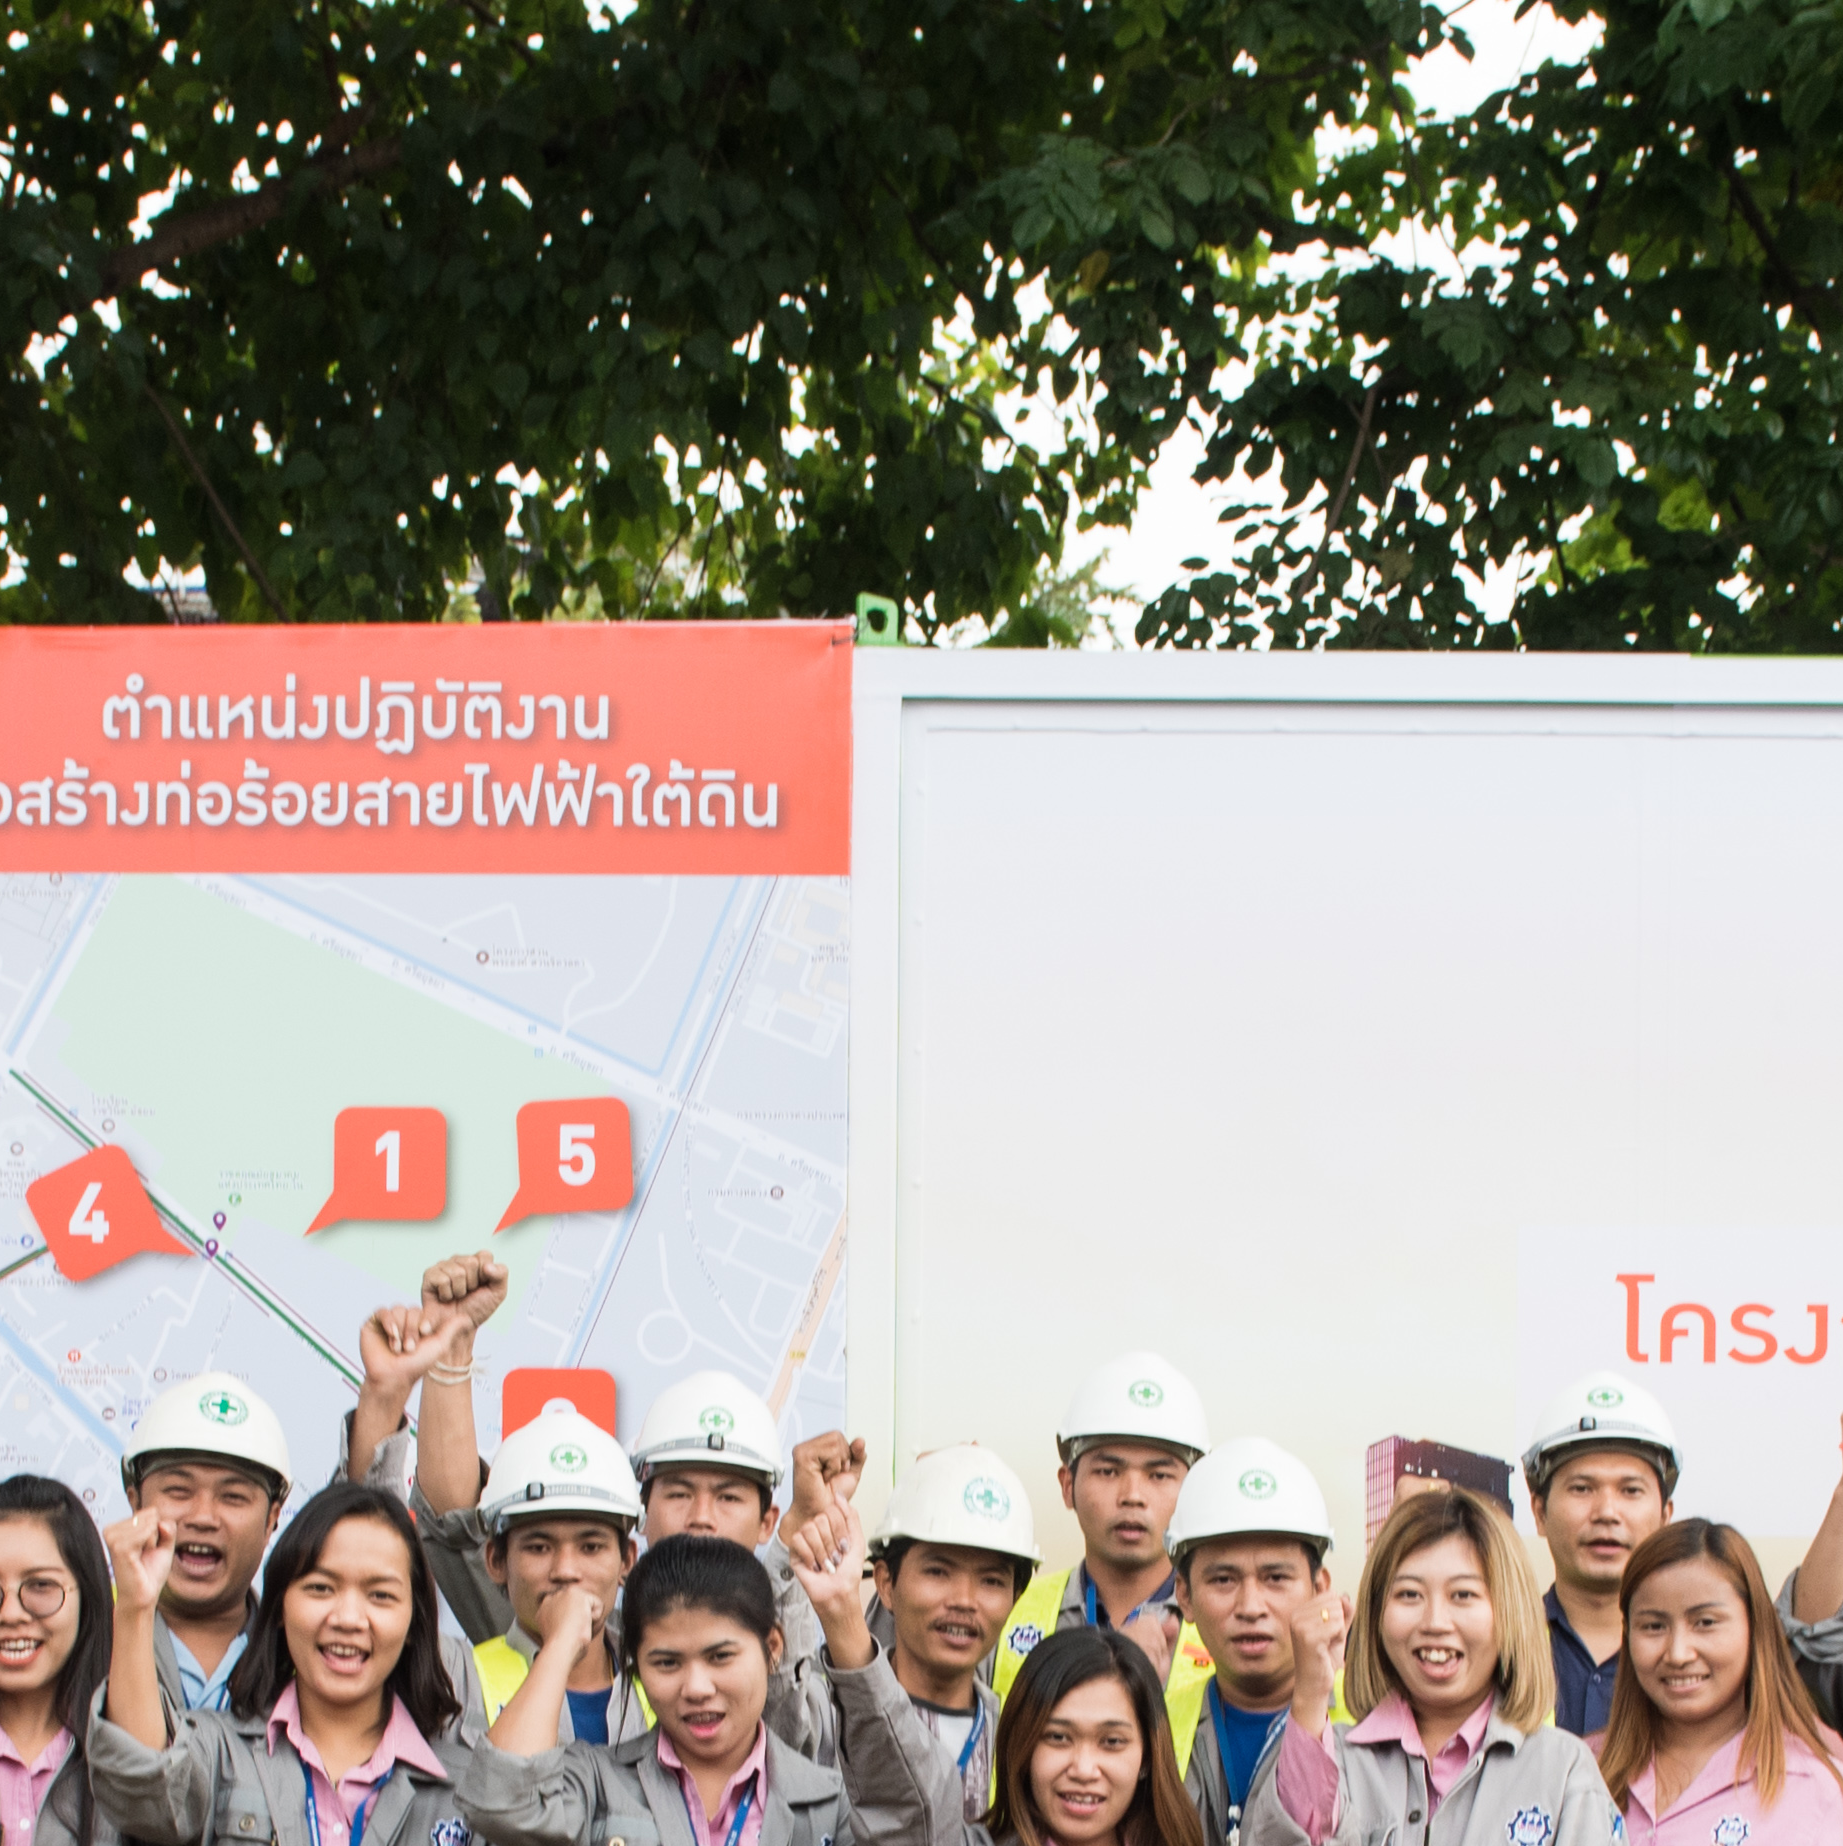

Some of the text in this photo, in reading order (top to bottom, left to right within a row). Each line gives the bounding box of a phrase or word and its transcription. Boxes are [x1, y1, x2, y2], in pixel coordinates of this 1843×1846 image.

[102, 675, 609, 755] ตำแหน่งปฏิบัติงาน
[374, 1131, 401, 1193] 1
[558, 1124, 595, 1187] 5
[69, 1182, 110, 1244] 4
